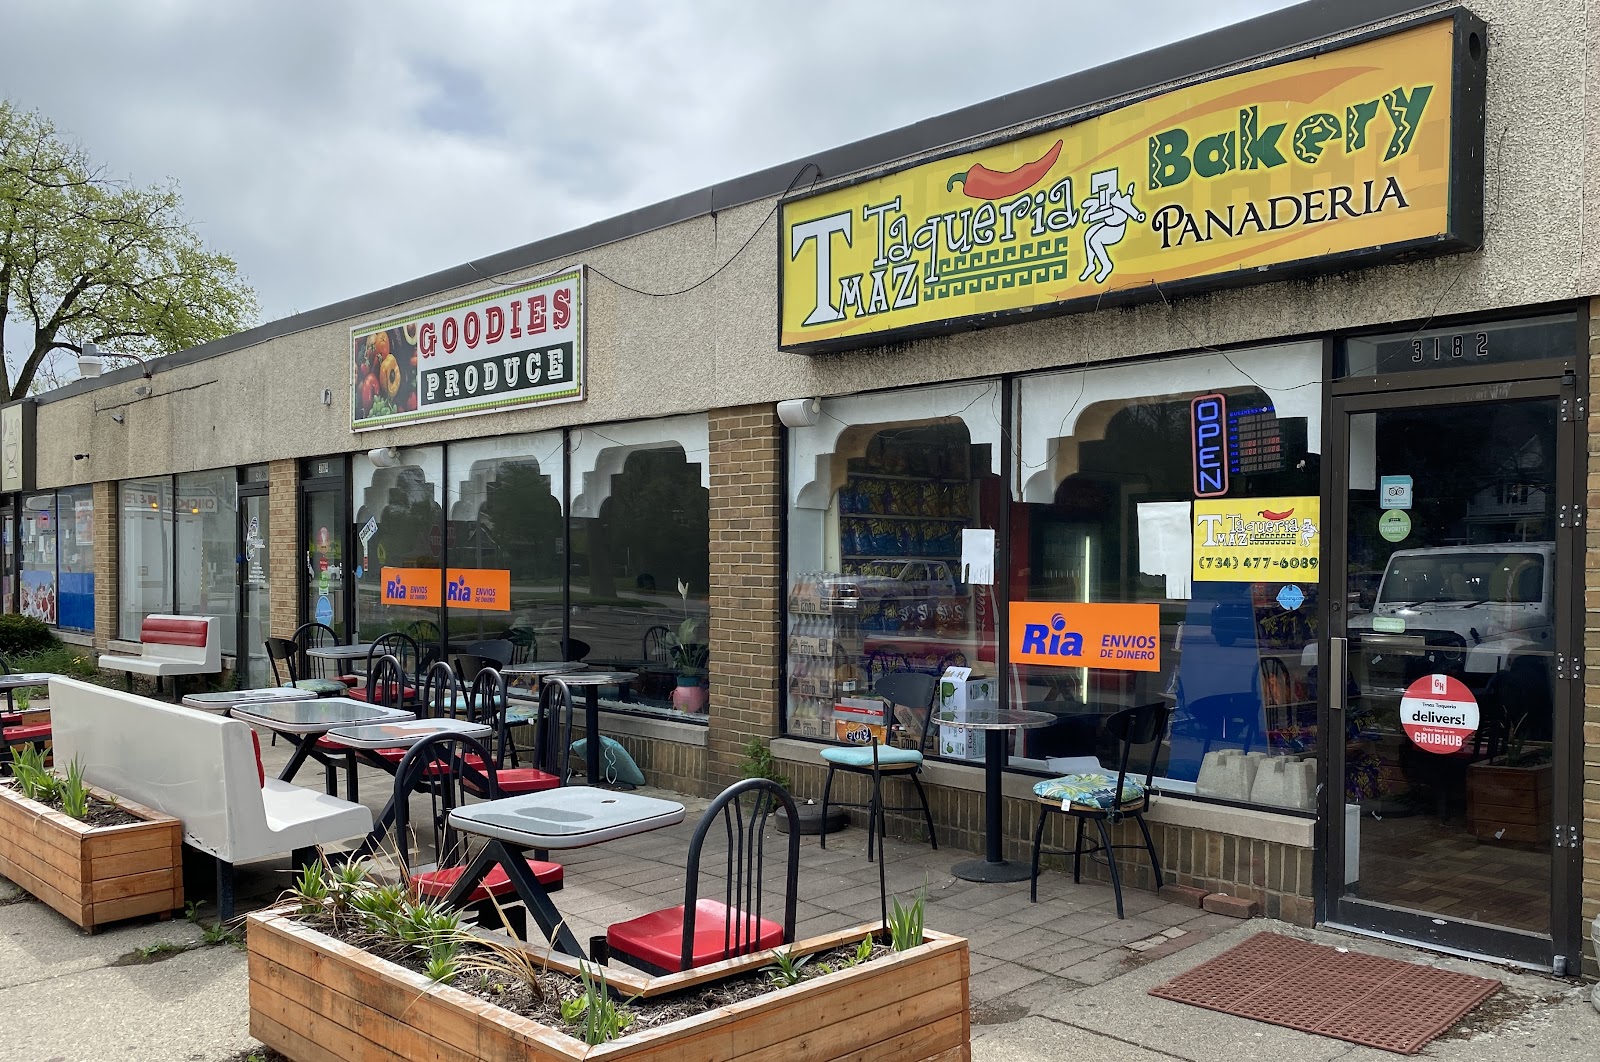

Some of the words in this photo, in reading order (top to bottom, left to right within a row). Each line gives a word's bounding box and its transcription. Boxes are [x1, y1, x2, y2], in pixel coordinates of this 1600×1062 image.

[1149, 85, 1434, 191] Bakery
[1152, 176, 1410, 250] PANADERIA
[863, 177, 1080, 284] Taqueria
[419, 288, 571, 359] GOODIES
[1412, 332, 1488, 362] 3182
[426, 348, 564, 401] PRODUCE
[1197, 401, 1222, 492] OPEN
[1226, 513, 1301, 541] Taqueria
[1199, 556, 1239, 570] (734)
[1243, 556, 1319, 570] 477-6089
[386, 575, 407, 599] Ria
[410, 586, 428, 594] ENVIOS
[447, 575, 471, 602] Ria
[475, 587, 496, 597] ENVIOS
[1021, 613, 1084, 656] Ria
[1101, 634, 1156, 649] ENVIOS
[1100, 649, 1114, 658] DE
[1116, 650, 1155, 660] DINERO
[1434, 679, 1444, 691] GH
[1412, 710, 1465, 726] delivers!
[1414, 731, 1463, 747] GRUBHUB
